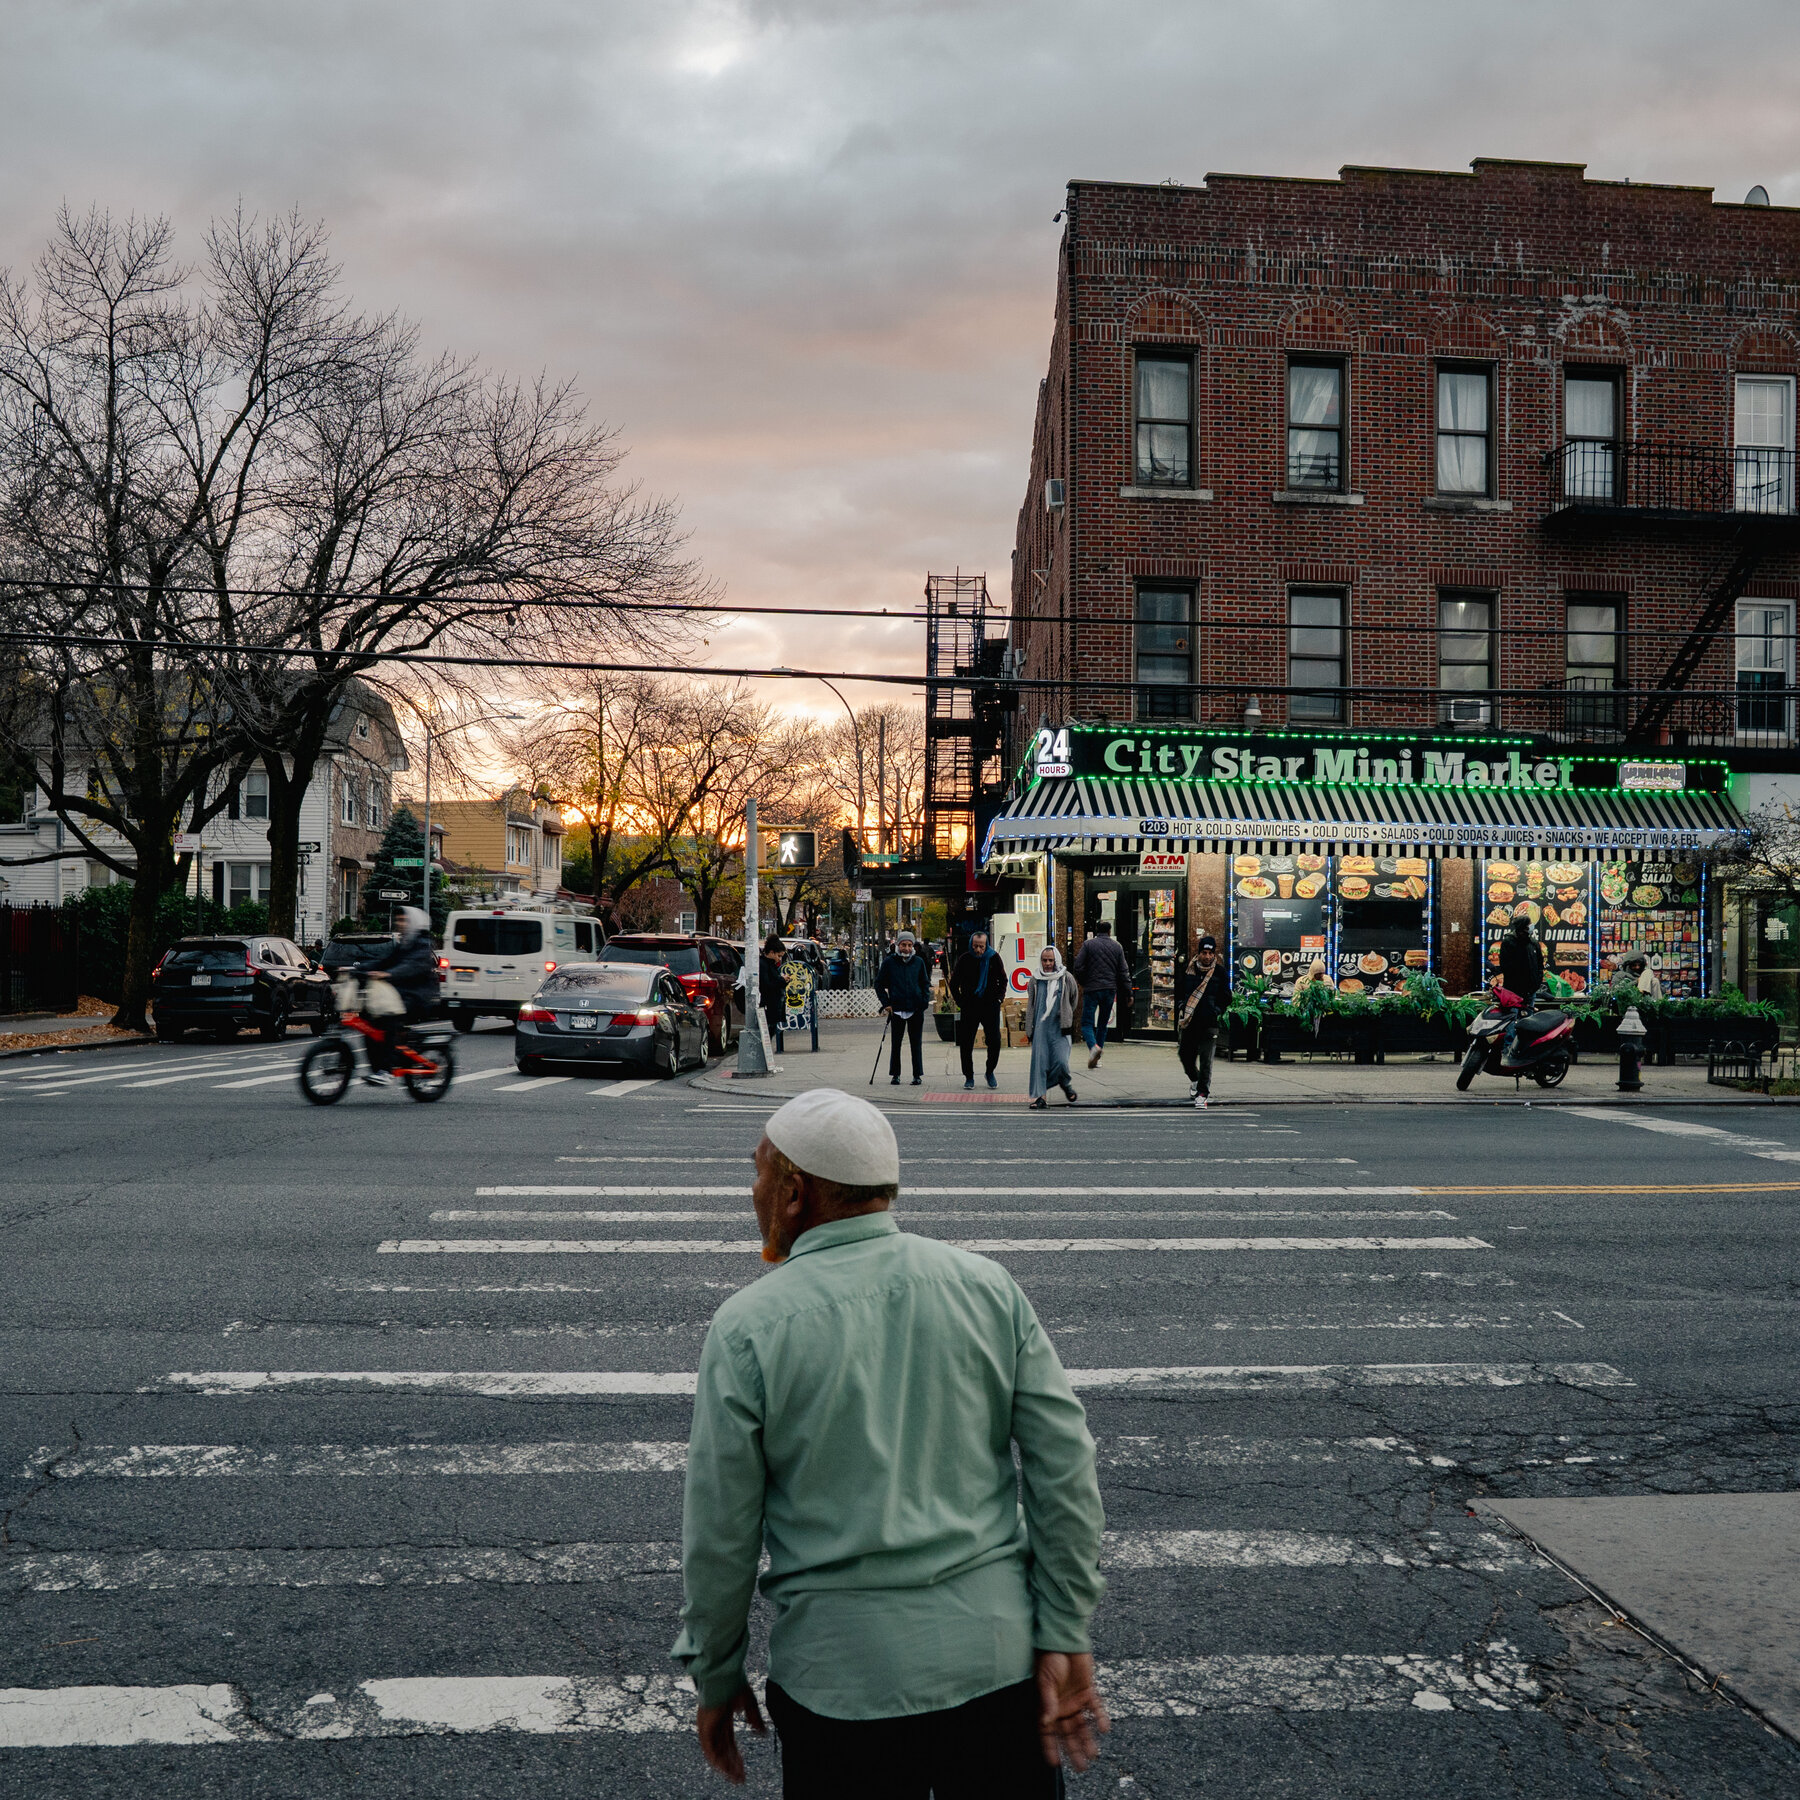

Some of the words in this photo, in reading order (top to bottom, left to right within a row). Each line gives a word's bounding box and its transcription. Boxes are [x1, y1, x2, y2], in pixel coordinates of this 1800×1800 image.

[1038, 728, 1071, 763] 24
[1104, 738, 1203, 780] City
[1211, 746, 1305, 782] Star
[1313, 747, 1414, 785] Mini
[1422, 751, 1574, 789] Market
[1039, 765, 1066, 774] HOURS
[1140, 821, 1168, 833] 1203
[1173, 822, 1193, 835] HOT
[1195, 823, 1203, 835] &
[1206, 823, 1232, 835] COLD
[1235, 823, 1300, 837] SANDWICHES
[1312, 825, 1339, 838] COLD
[1344, 826, 1370, 838] CUTS
[1381, 827, 1419, 840] SALADS
[1429, 828, 1454, 841] COLD
[1456, 829, 1489, 841] SODAS
[1491, 830, 1499, 841] &
[1501, 830, 1535, 842] JUICES
[1545, 831, 1583, 843] SNACKS
[1594, 832, 1609, 844] WE
[1611, 832, 1648, 845] ACCEPT
[1681, 834, 1699, 846] EBT
[1142, 855, 1185, 865] ATM
[1641, 863, 1673, 873] FRESH
[1640, 873, 1674, 884] SALAD
[1531, 929, 1539, 941] &
[1544, 929, 1587, 941] DINNER
[1293, 952, 1327, 962] BREAK
[1338, 953, 1364, 963] FAST
